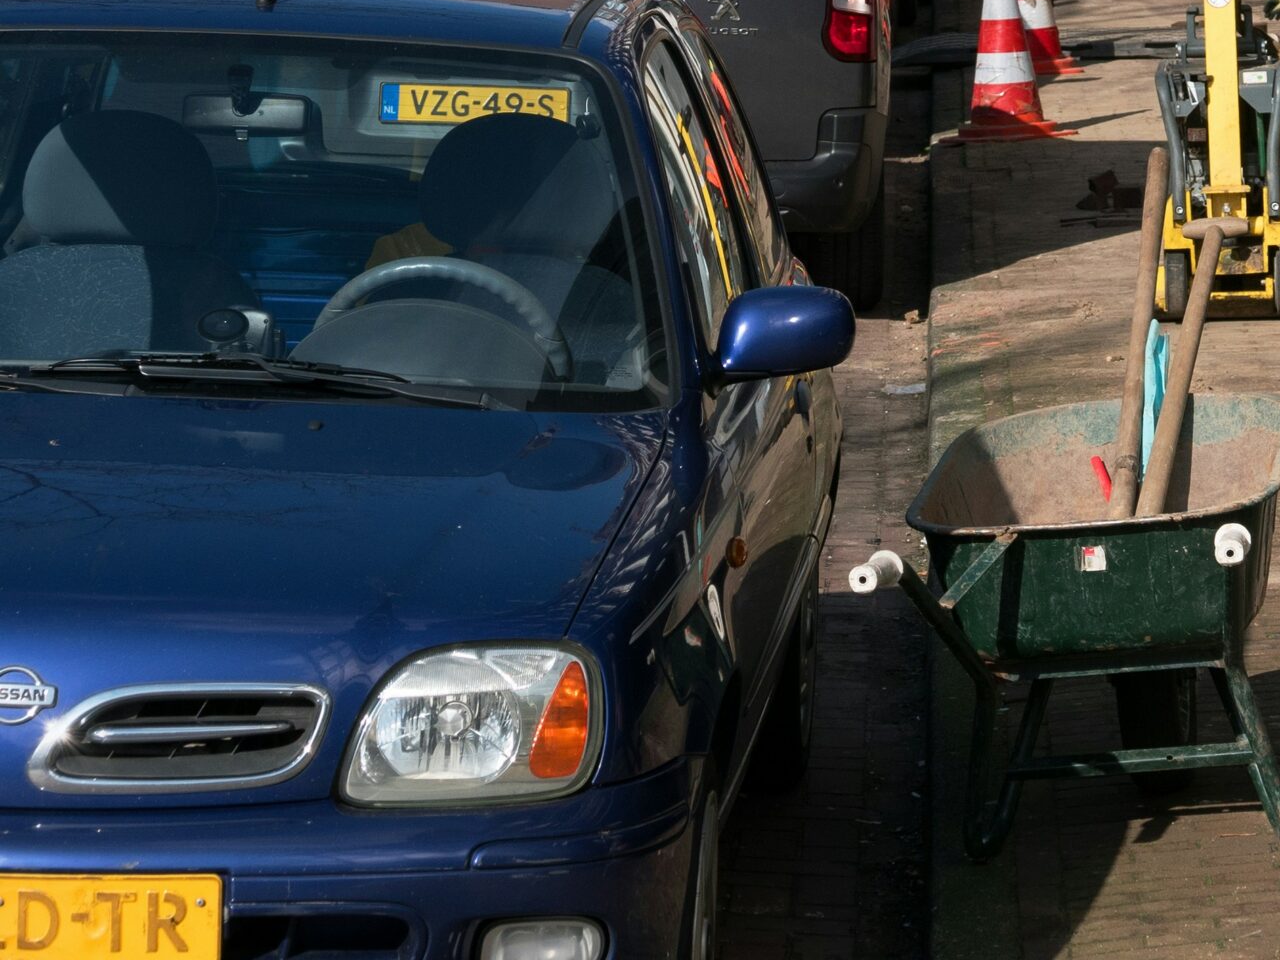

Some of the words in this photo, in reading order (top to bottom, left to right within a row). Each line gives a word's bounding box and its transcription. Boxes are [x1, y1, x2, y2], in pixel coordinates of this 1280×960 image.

[383, 105, 396, 114] NL
[411, 90, 554, 118] VZG-49-S
[0, 890, 190, 954] D-TR
